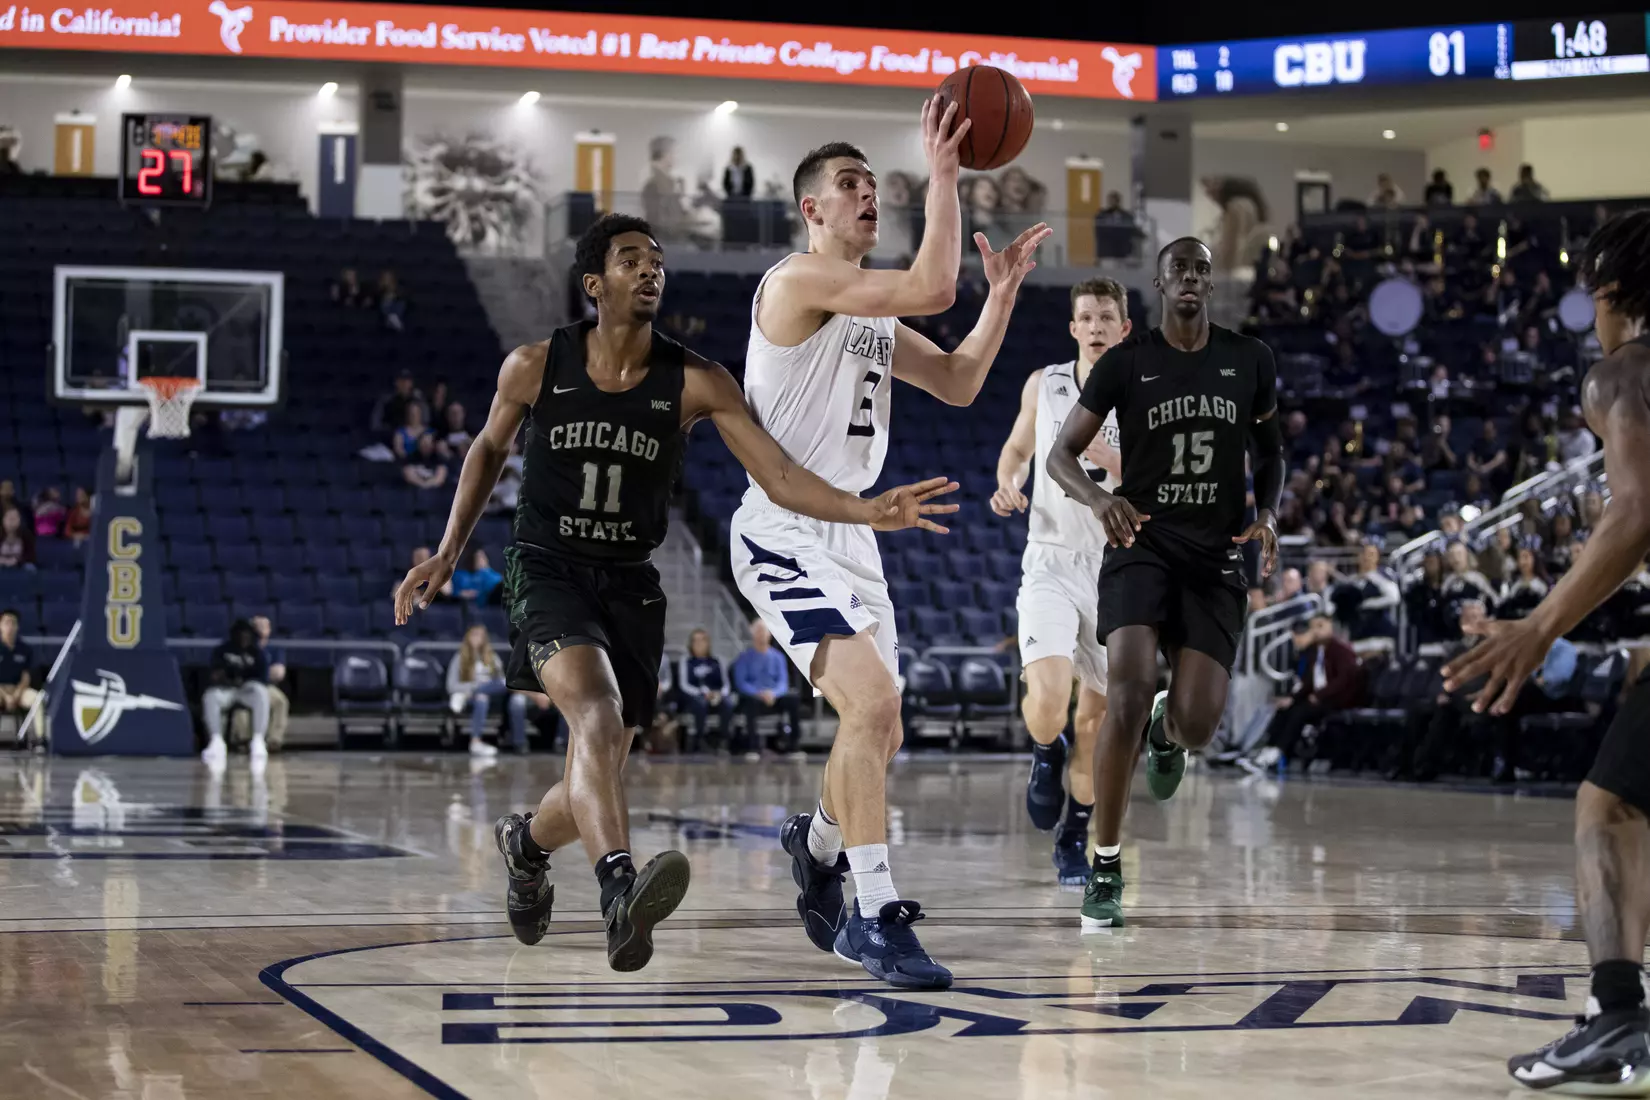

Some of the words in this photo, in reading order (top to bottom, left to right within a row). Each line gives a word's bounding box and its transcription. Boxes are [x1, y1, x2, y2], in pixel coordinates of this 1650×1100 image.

[20, 6, 45, 32] in
[50, 8, 182, 38] California!
[1551, 19, 1608, 58] 1:48
[269, 15, 371, 46] Provider
[375, 20, 437, 48] Food
[441, 23, 525, 53] Service
[528, 27, 598, 56] Voted
[638, 32, 690, 60] Best
[692, 35, 777, 65] Private
[779, 40, 867, 75] College
[869, 45, 930, 74] Food
[932, 50, 957, 75] in
[1273, 38, 1366, 88] CBU
[1428, 30, 1466, 77] 81
[138, 148, 192, 195] 27
[1219, 368, 1237, 376] WAC
[650, 399, 672, 411] WAC
[1147, 394, 1237, 430] CHICAGO
[550, 421, 660, 461] CHICAGO
[1171, 431, 1215, 475] 15
[579, 461, 623, 513] 11
[1157, 482, 1218, 505] STATE
[559, 515, 637, 542] STATE
[105, 516, 143, 649] CBU
